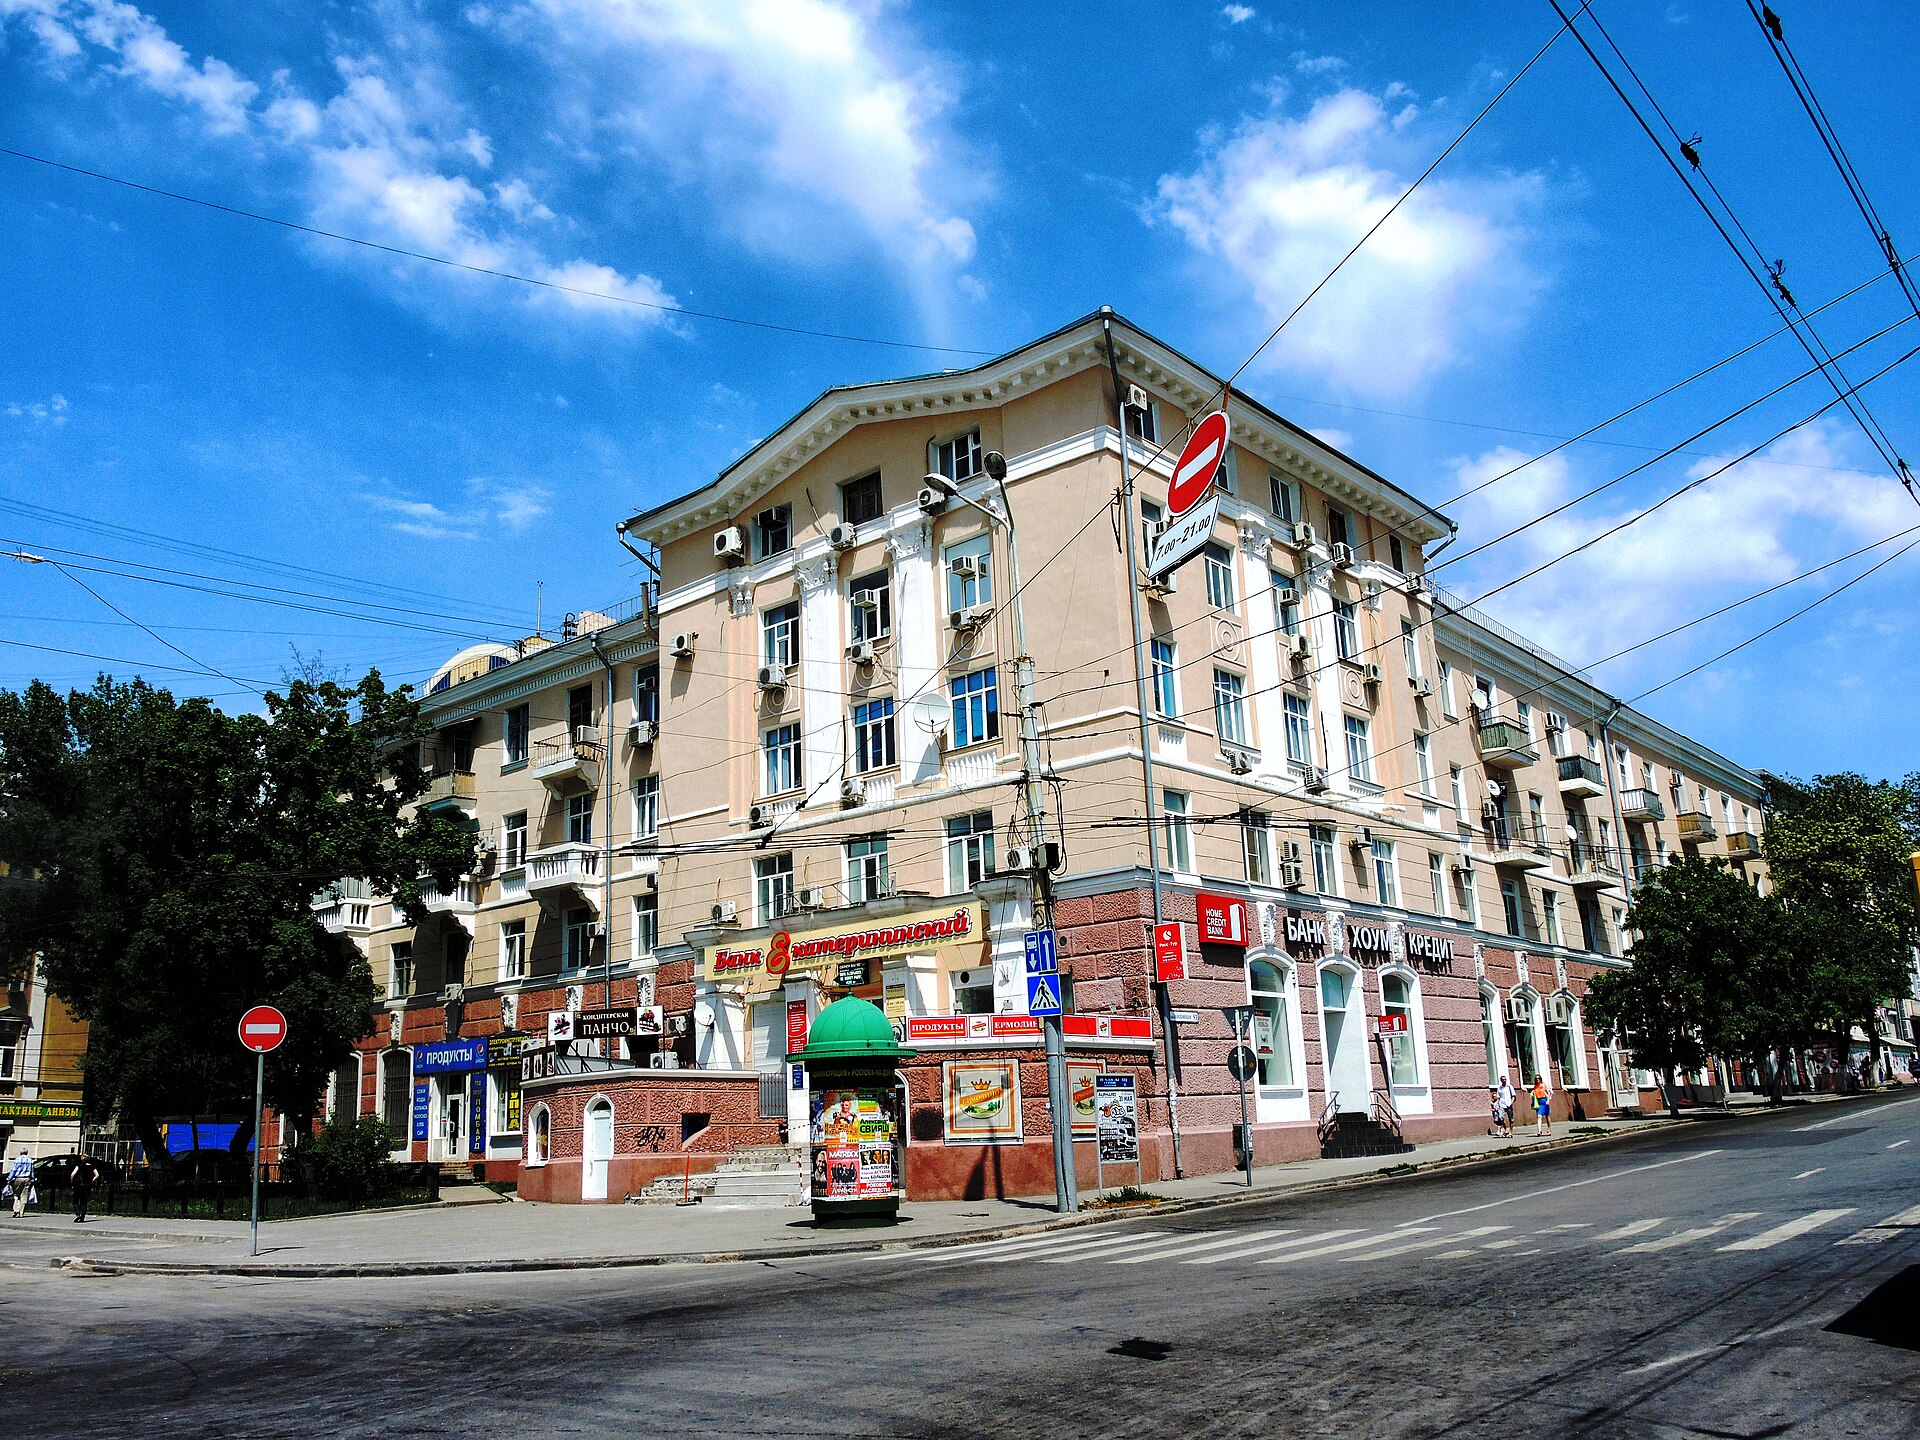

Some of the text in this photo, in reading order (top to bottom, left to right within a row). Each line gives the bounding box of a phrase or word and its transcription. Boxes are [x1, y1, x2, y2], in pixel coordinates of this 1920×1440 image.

[1155, 515, 1211, 561] 7.00-21.00
[1206, 908, 1223, 918] HOME
[1206, 917, 1227, 927] CREDIT
[1207, 926, 1224, 936] BANK
[713, 907, 973, 975] Банк Екатерининский
[1286, 916, 1455, 963] БАНК ХОУМ КРЕДИТ
[582, 1012, 629, 1020] КОНДИТЕРСКАЯ
[583, 1021, 630, 1035] ПАНЧО
[911, 1023, 964, 1032] ПРОДУКТЫ
[426, 1048, 473, 1066] ПРОДУКТЫ
[46, 1107, 79, 1117] ЛИНЗЫ
